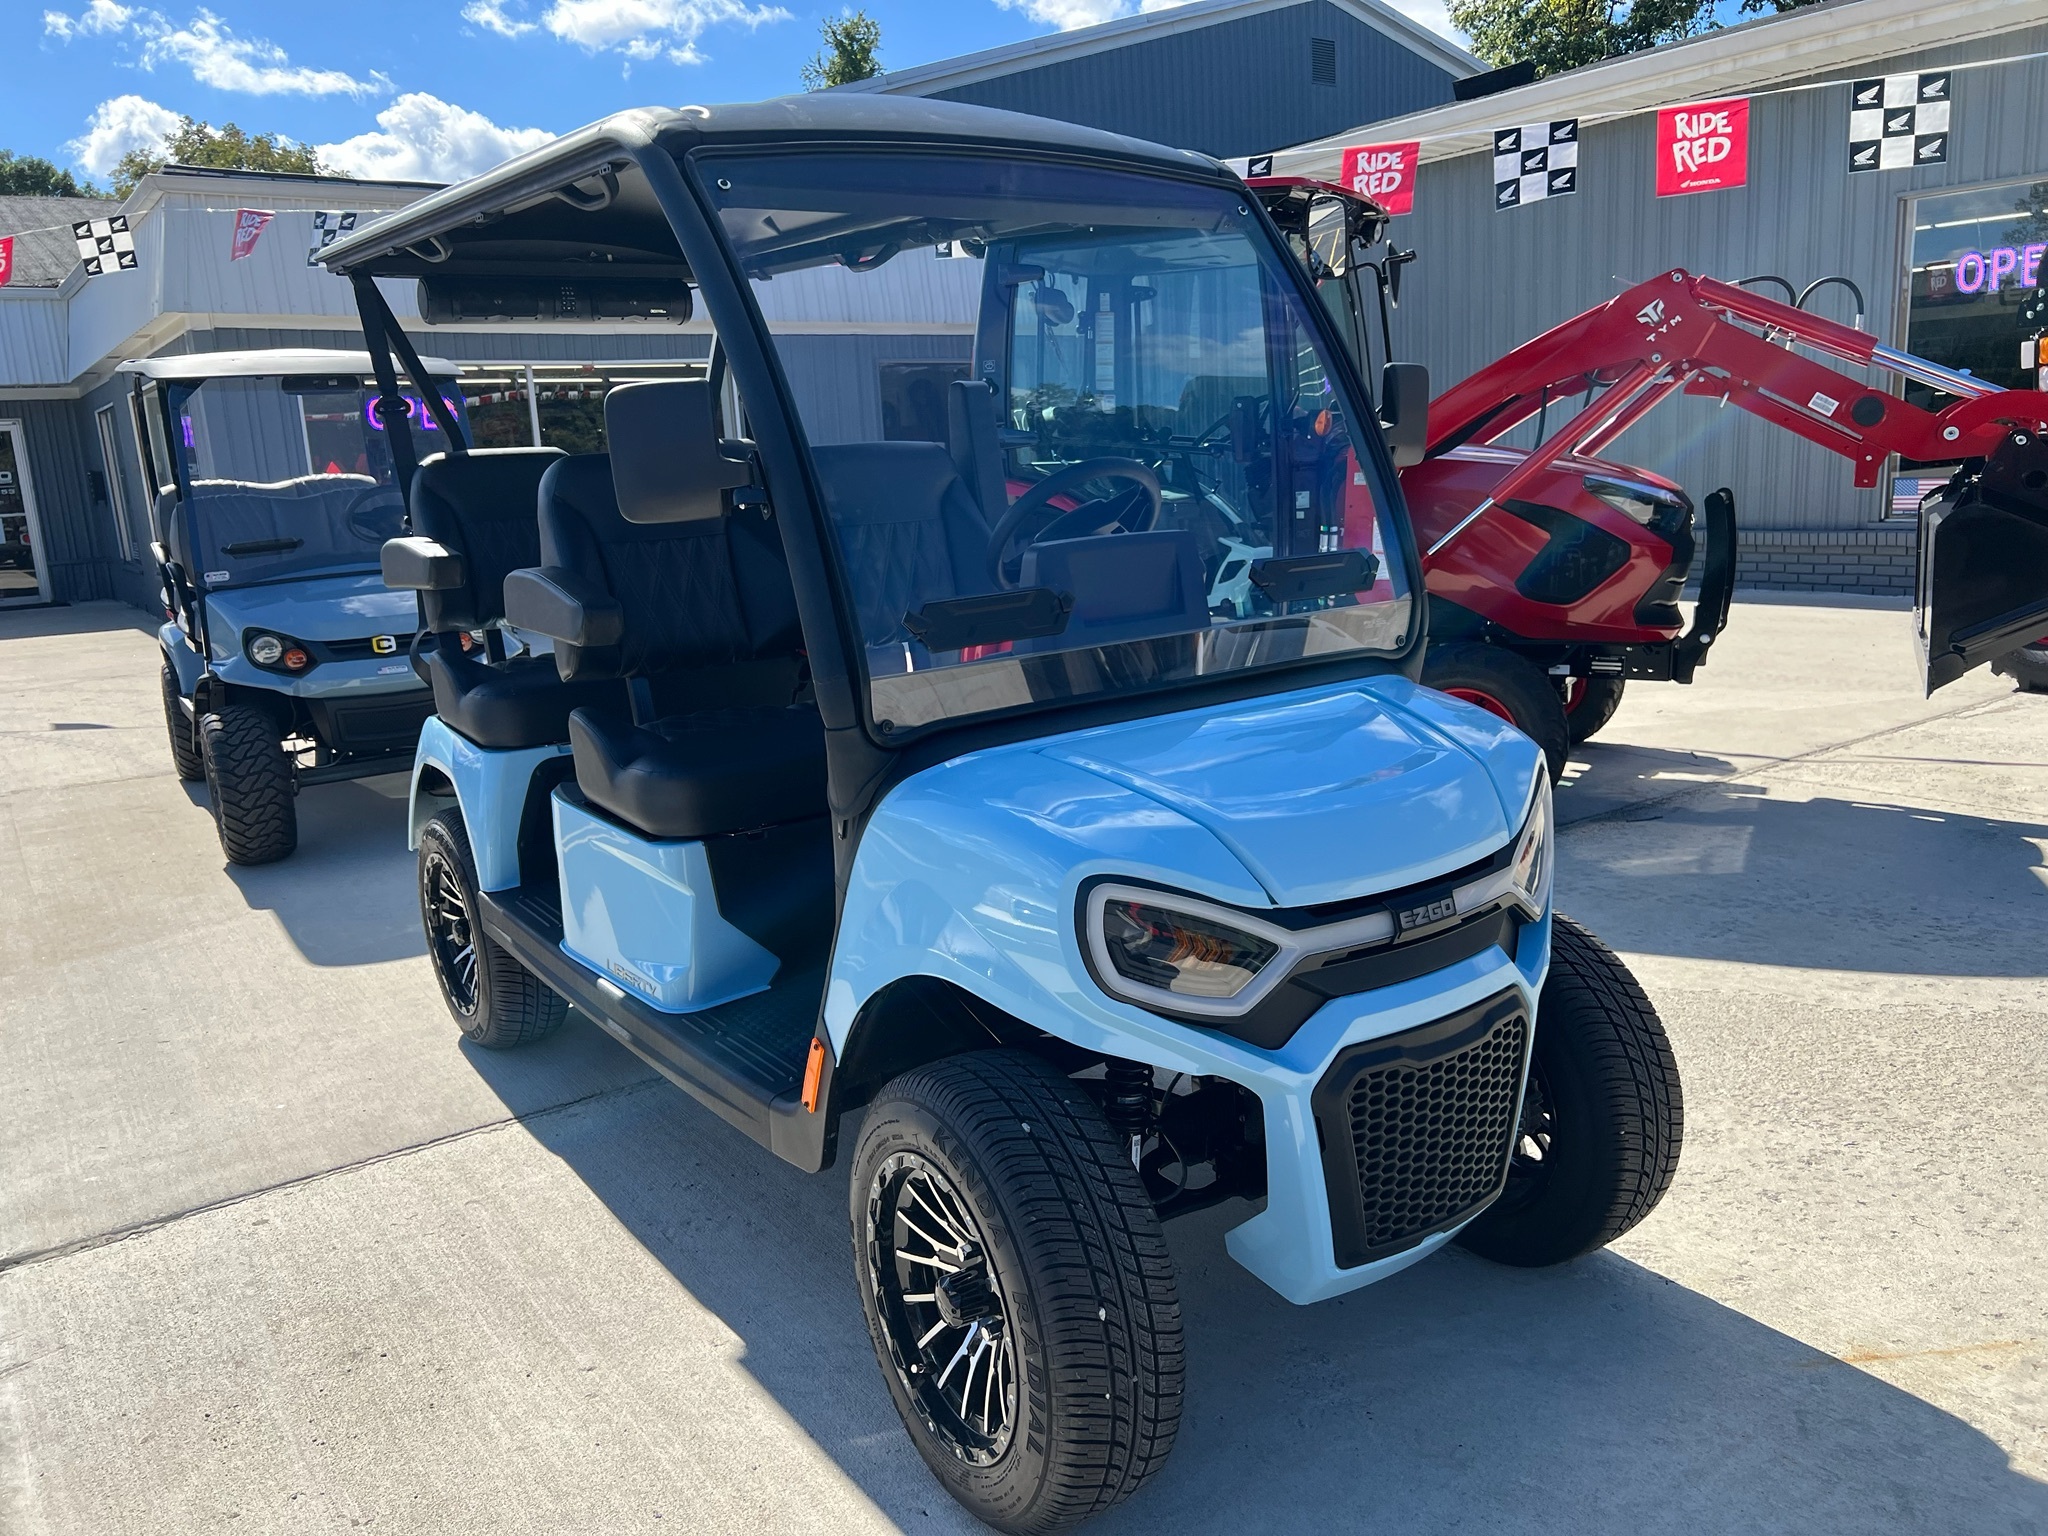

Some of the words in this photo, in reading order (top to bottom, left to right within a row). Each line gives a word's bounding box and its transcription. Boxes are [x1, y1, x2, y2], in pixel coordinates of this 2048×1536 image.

[1674, 111, 1733, 140] RIDE
[1356, 151, 1405, 174] RIDE
[1672, 136, 1732, 174] RED
[1353, 171, 1402, 198] RED
[1688, 178, 1722, 187] HONDA
[241, 212, 262, 228] RIDE
[1645, 314, 1683, 343] TYM
[606, 957, 658, 998] LIBERTY
[931, 1126, 1008, 1250] KENDA
[1011, 1290, 1047, 1459] RADIAL
